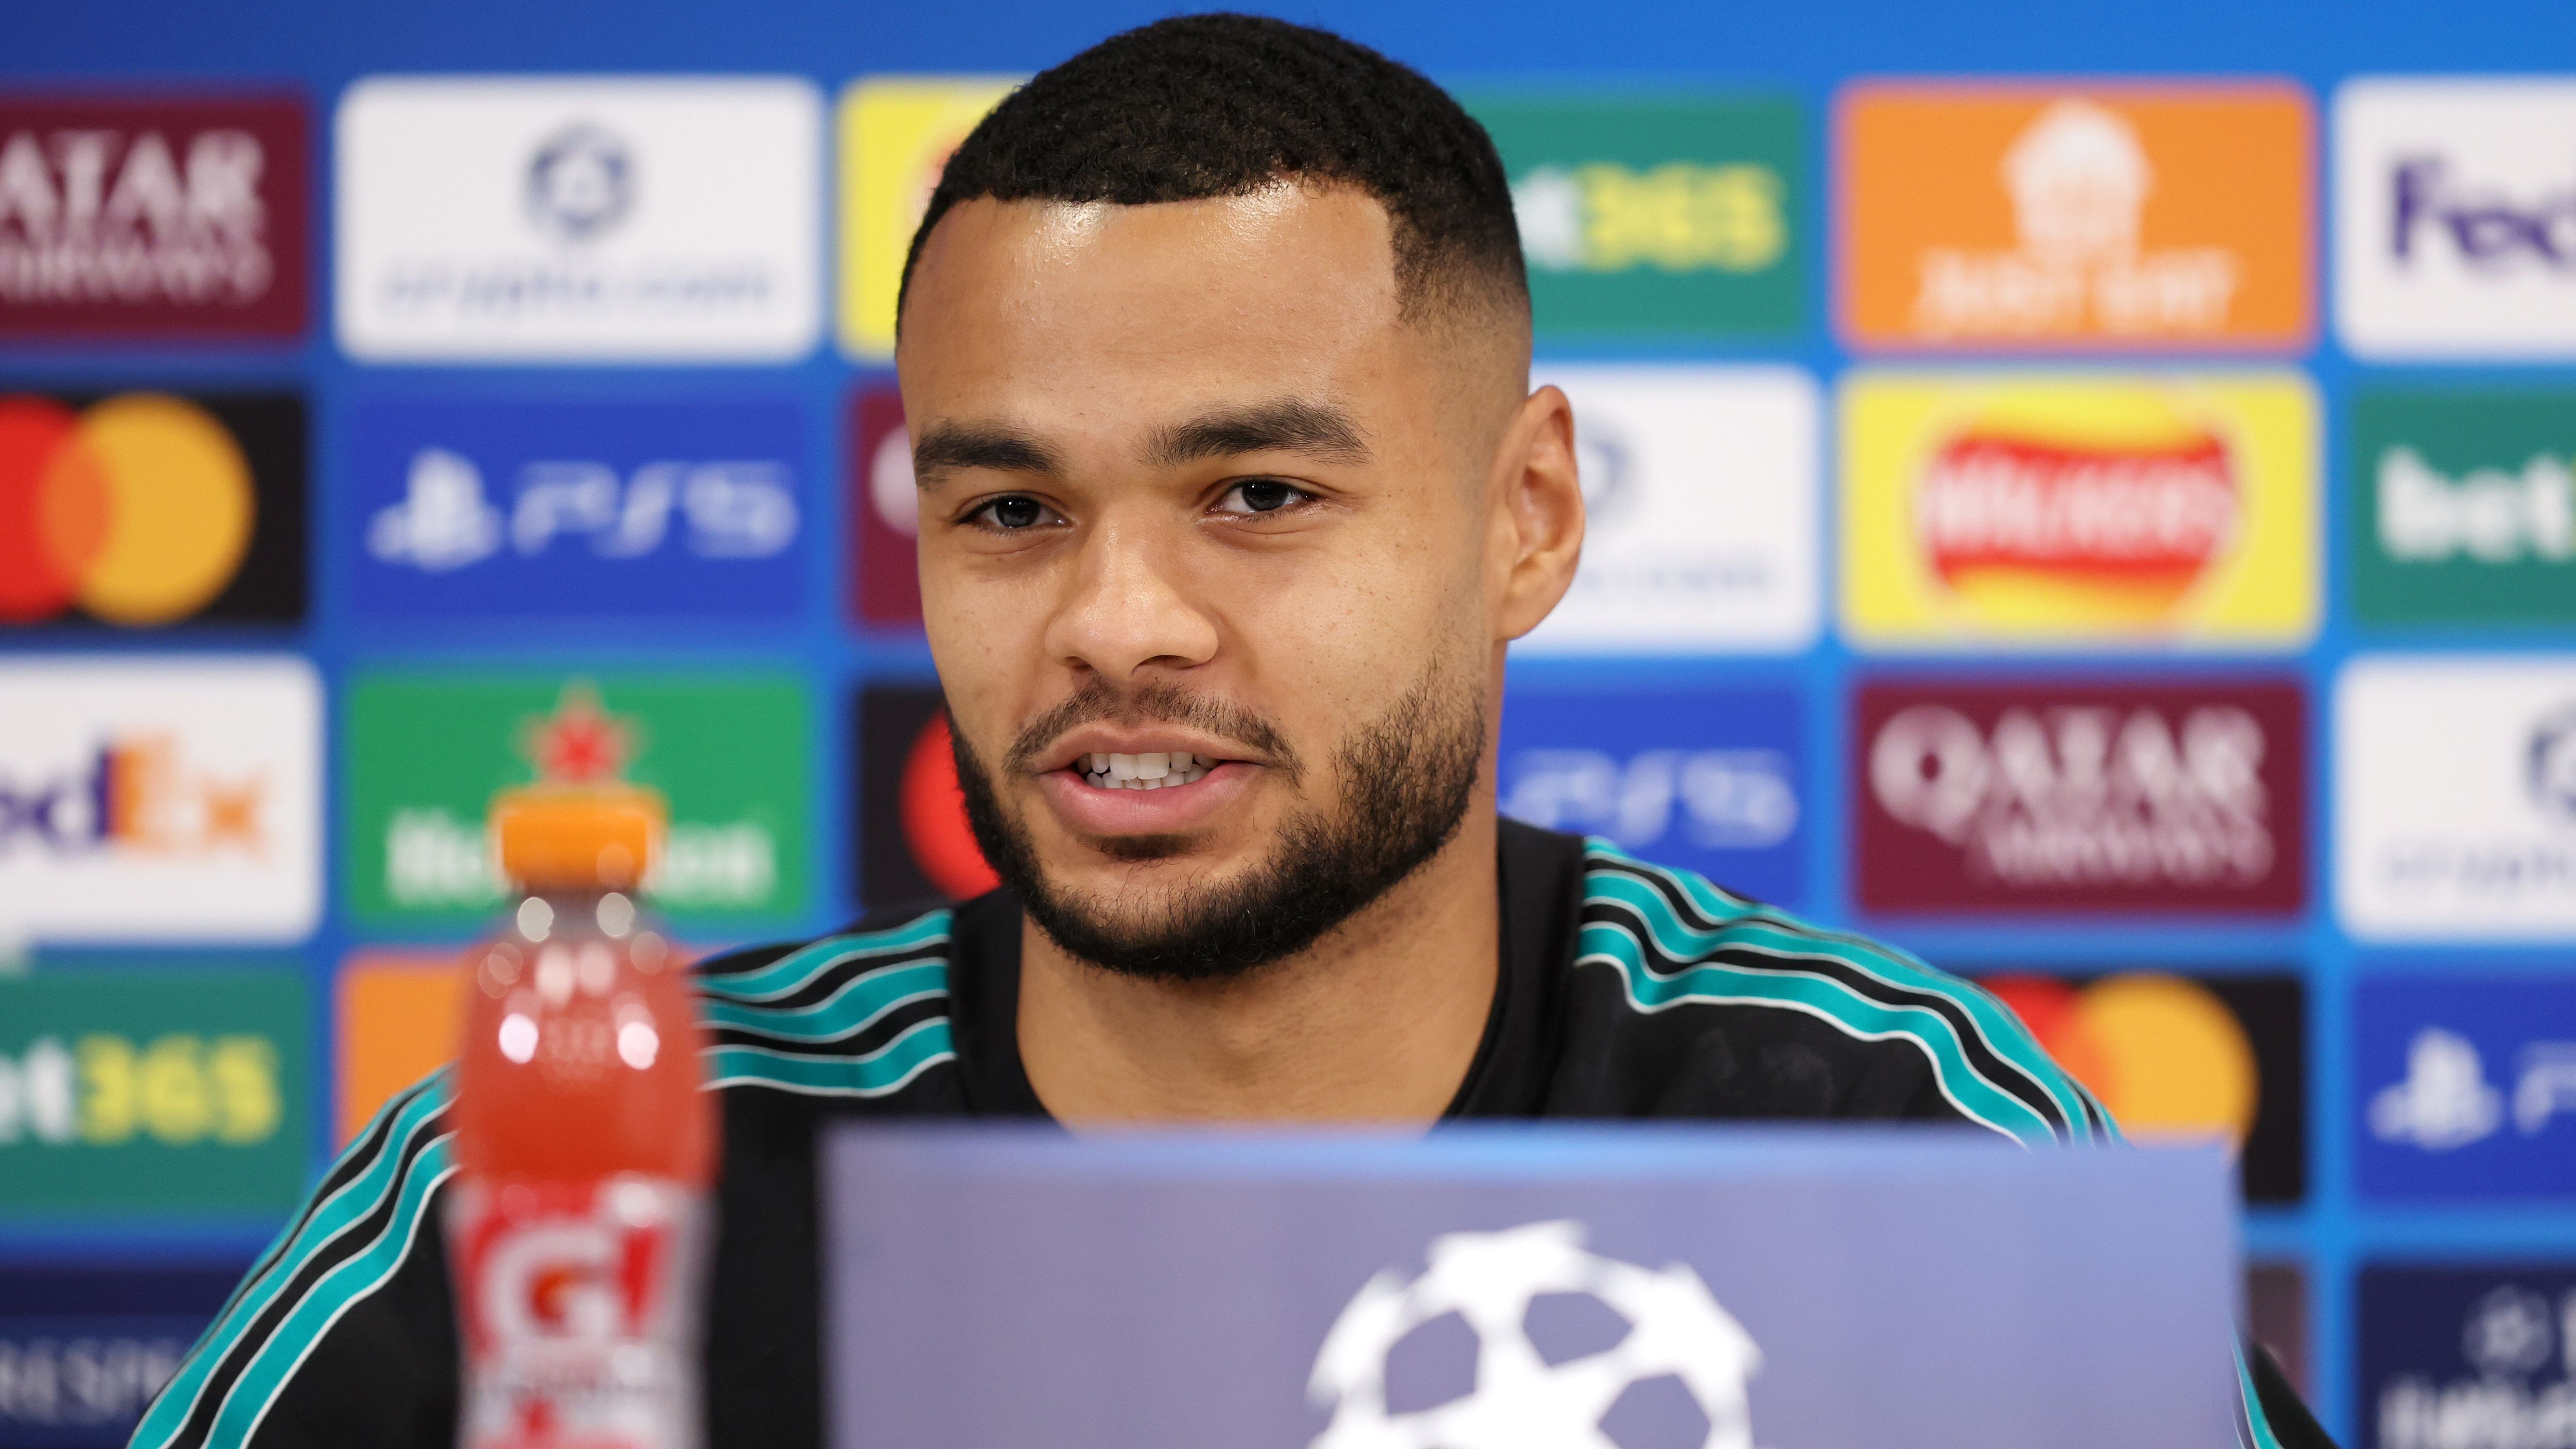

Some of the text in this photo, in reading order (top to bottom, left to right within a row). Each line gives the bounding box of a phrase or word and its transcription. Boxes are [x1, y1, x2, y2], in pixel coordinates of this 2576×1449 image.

[381, 264, 775, 318] crypto.com
[1916, 248, 2244, 332] JUST EAT
[515, 461, 799, 558] PS5
[1508, 749, 1797, 849] PS5
[1871, 706, 2265, 845] QATAR
[1982, 809, 2272, 884] AIRWAYS
